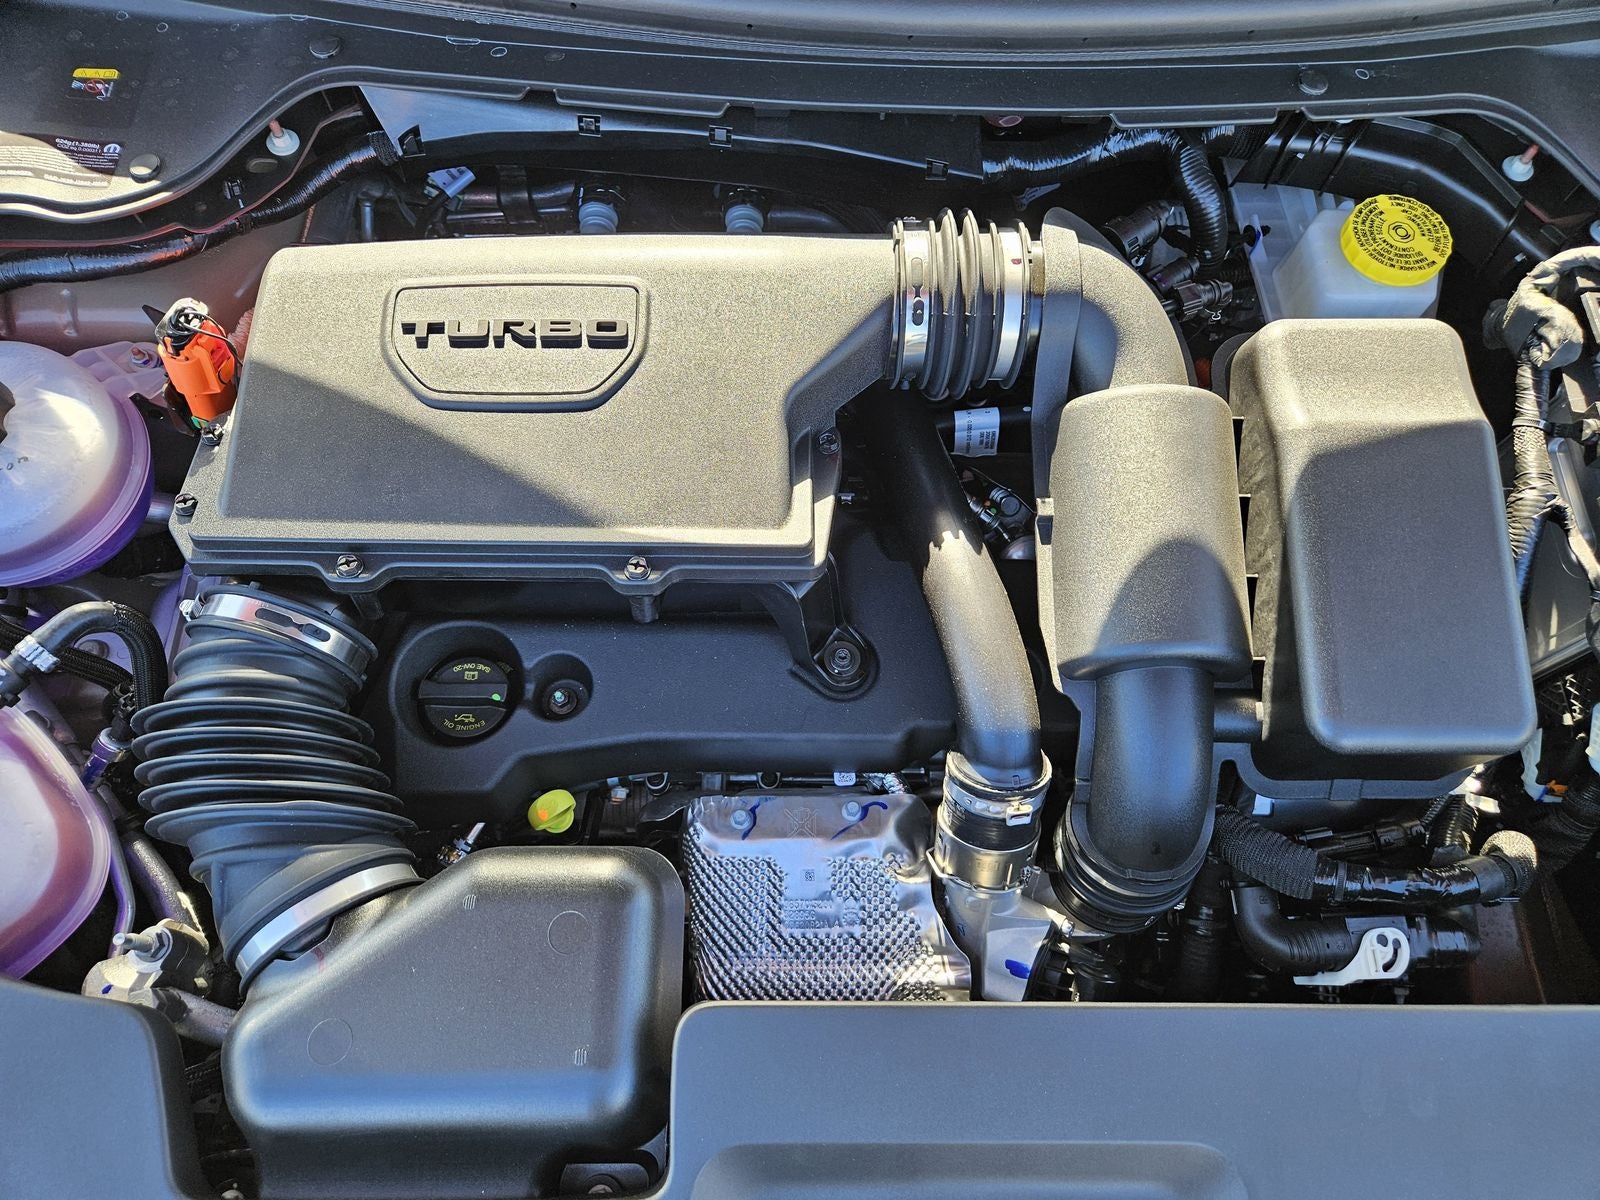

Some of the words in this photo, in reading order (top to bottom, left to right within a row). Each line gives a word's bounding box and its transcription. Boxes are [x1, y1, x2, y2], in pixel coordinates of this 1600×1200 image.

[1353, 226, 1366, 247] BOUCHON
[1426, 228, 1434, 242] CLEAN
[1379, 237, 1415, 253] CONTENANT
[1380, 246, 1392, 255] DOT
[1368, 252, 1396, 268] NETTOYER
[1412, 257, 1428, 265] AVANT
[401, 320, 628, 349] TURBO
[453, 663, 476, 673] 0W-20
[476, 663, 491, 673] SAE
[443, 718, 454, 729] OIL
[456, 720, 486, 731] ENGINE
